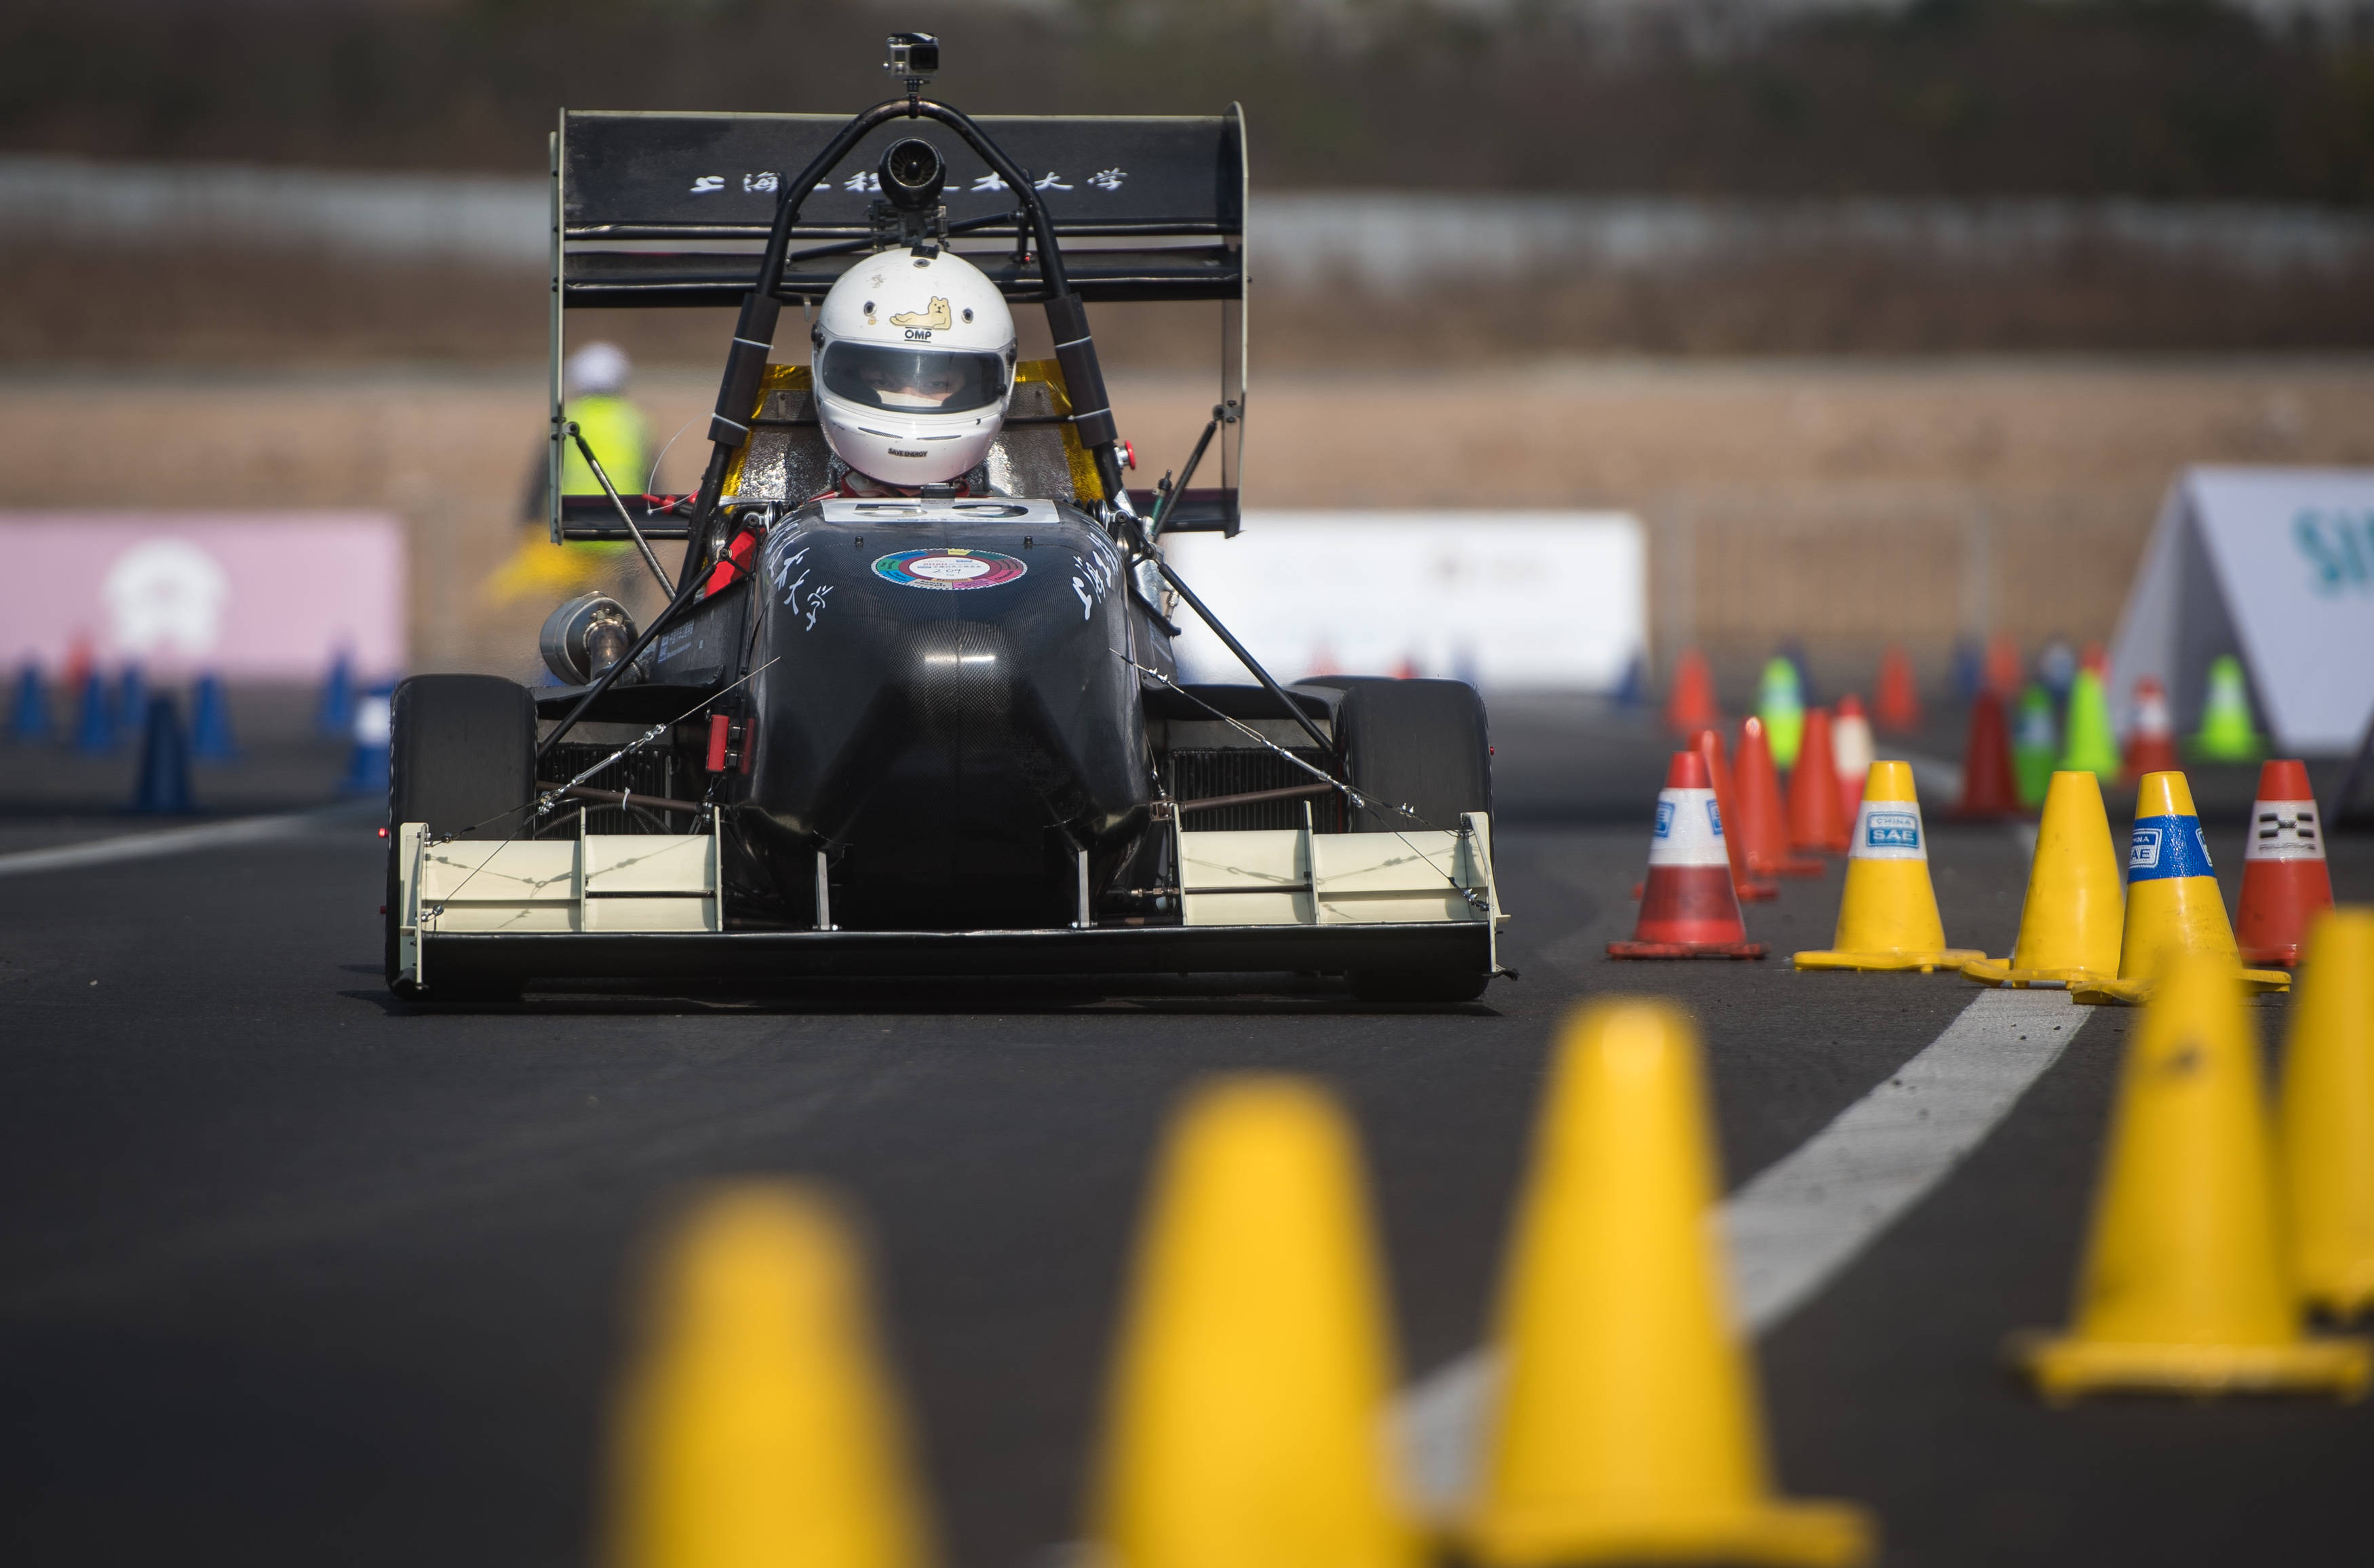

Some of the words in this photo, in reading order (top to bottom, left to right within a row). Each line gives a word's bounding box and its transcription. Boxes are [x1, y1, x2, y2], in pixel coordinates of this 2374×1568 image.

[689, 167, 1129, 193] 上海程术大学
[905, 330, 931, 340] OMP
[888, 448, 903, 456] SAVE
[1873, 829, 1914, 841] SAE
[2130, 848, 2151, 859] AE
